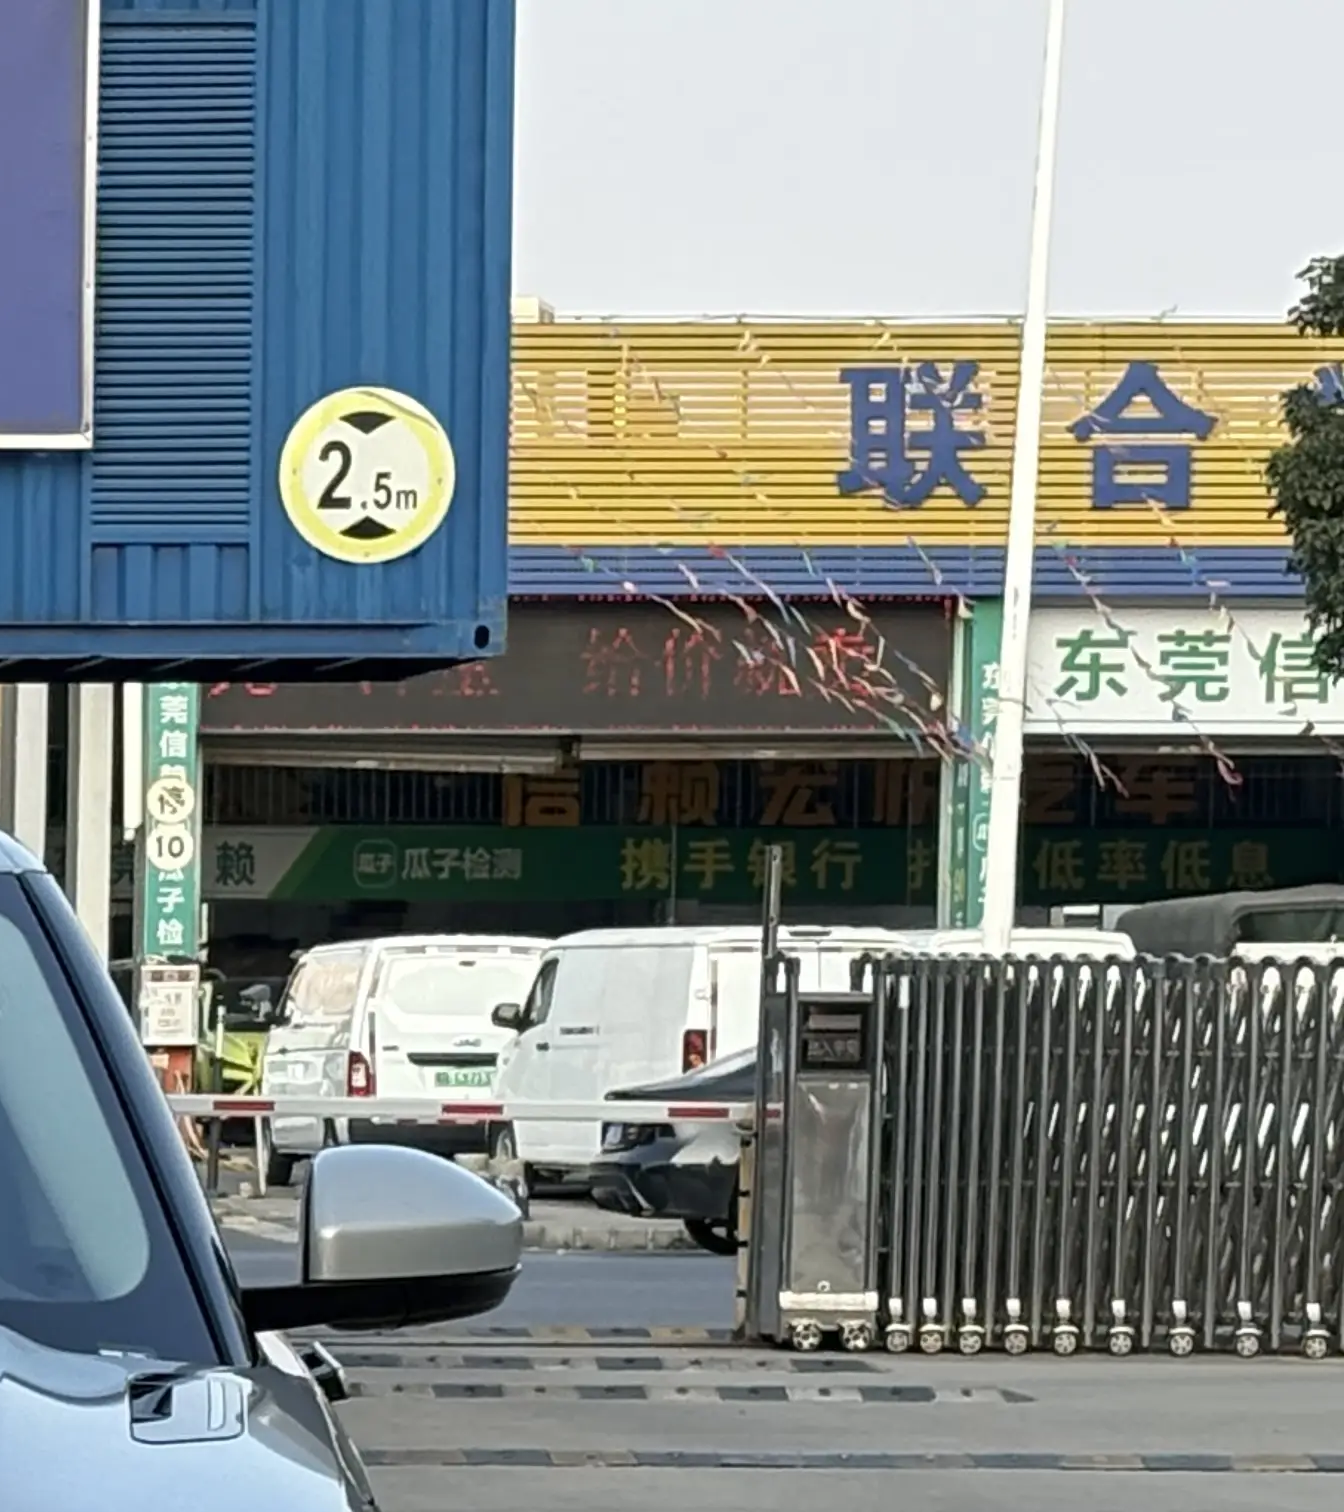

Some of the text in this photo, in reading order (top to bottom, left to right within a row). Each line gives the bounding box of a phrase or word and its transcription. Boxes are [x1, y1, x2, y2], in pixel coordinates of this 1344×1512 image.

[836, 360, 1344, 510] 联合
[401, 846, 523, 881] 瓜子检测
